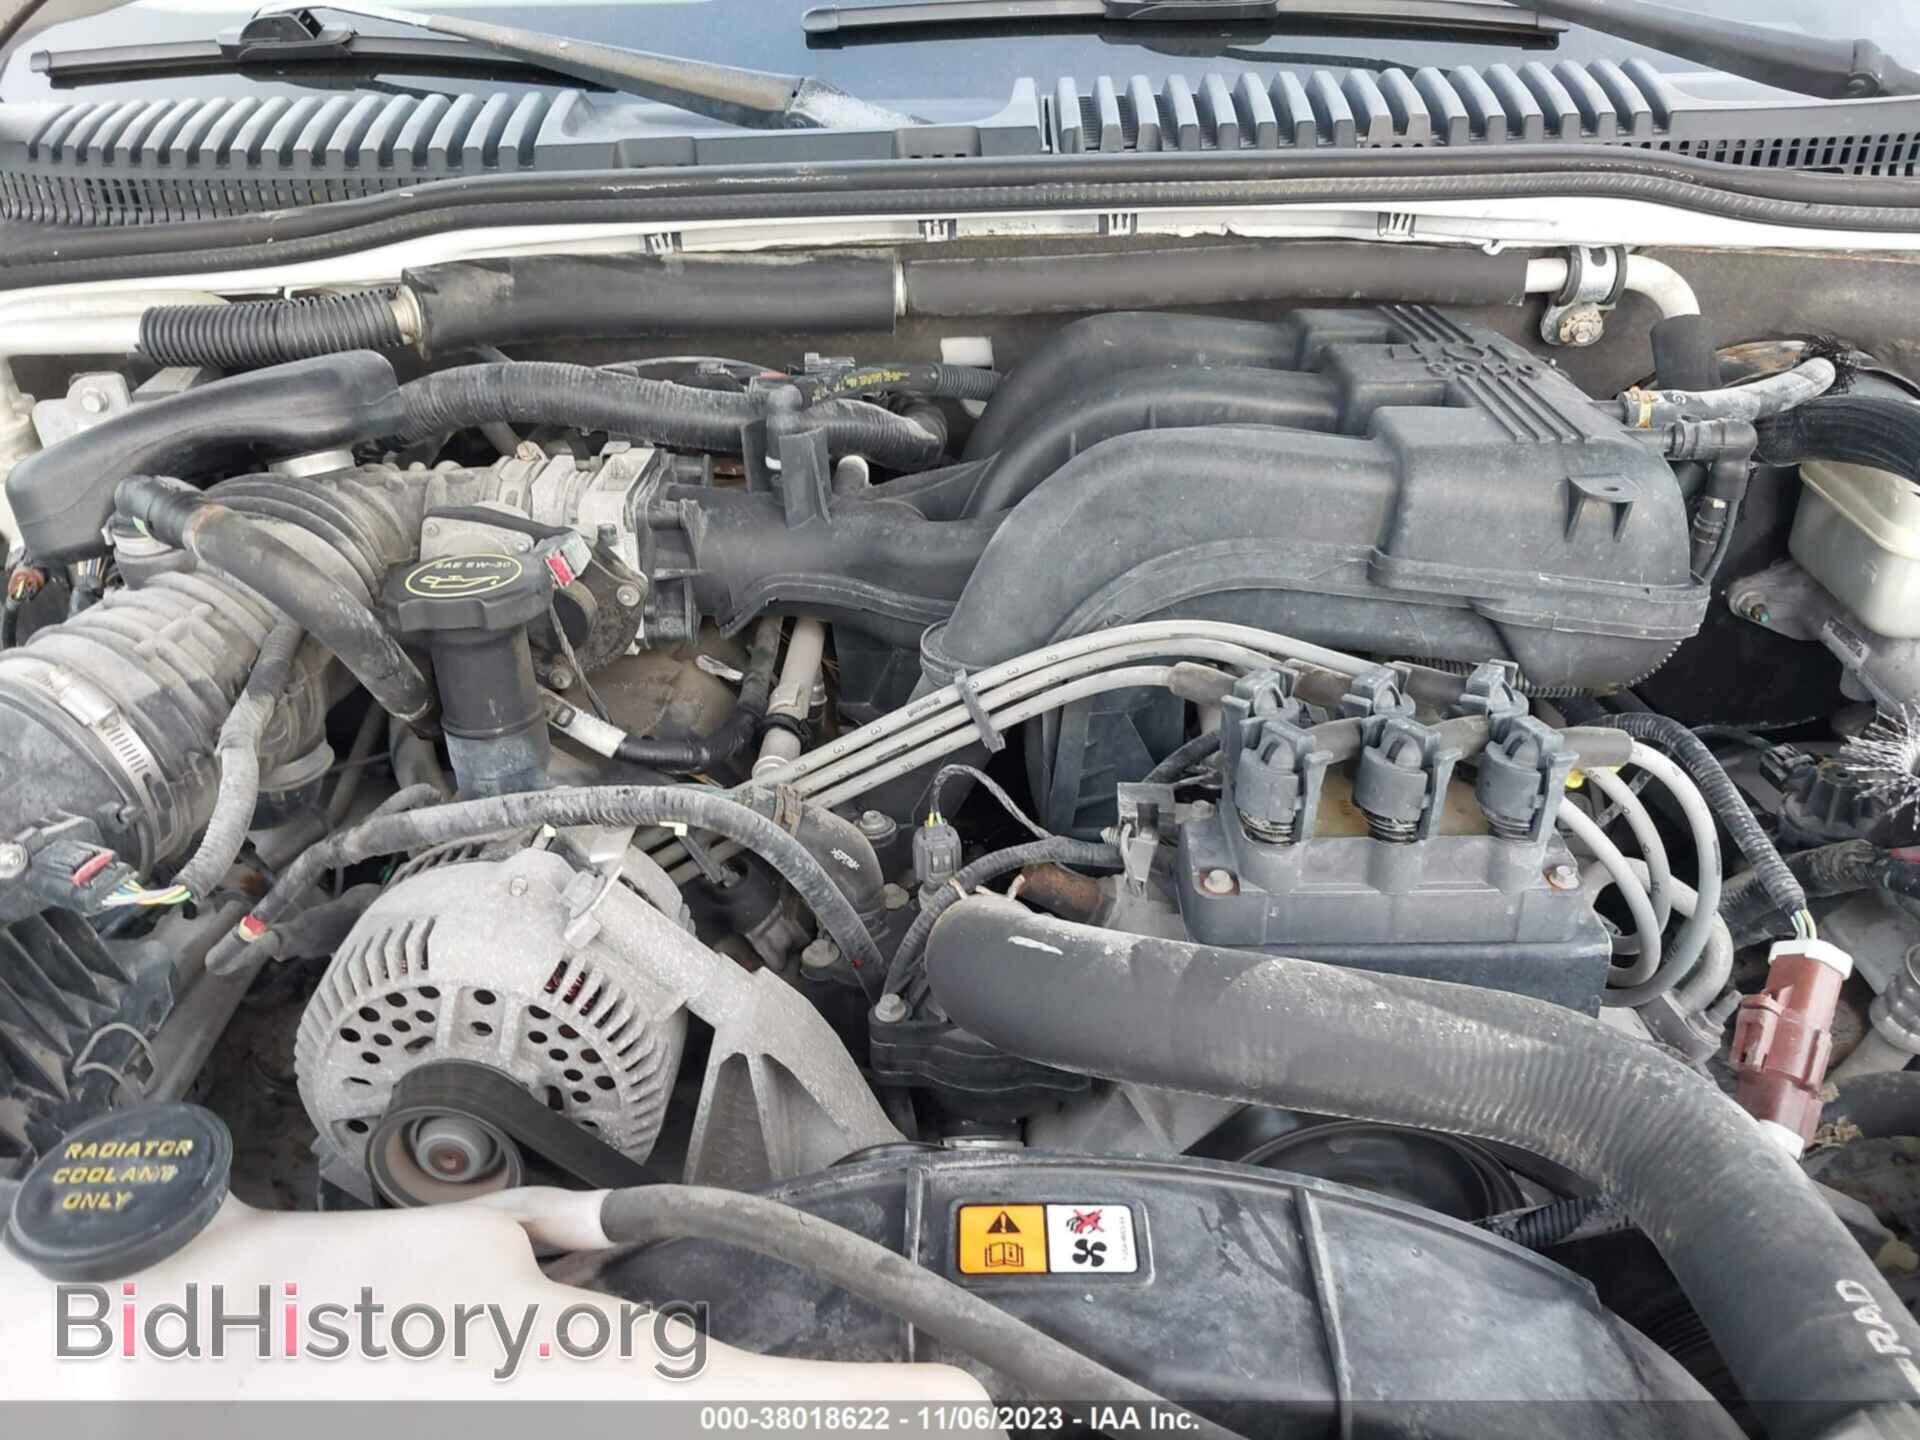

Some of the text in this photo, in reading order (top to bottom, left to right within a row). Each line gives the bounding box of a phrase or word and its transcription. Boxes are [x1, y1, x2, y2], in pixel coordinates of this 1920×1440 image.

[64, 1139, 194, 1159] RADIATOR
[52, 1164, 178, 1184] COOLANT
[62, 1191, 133, 1212] ONLY
